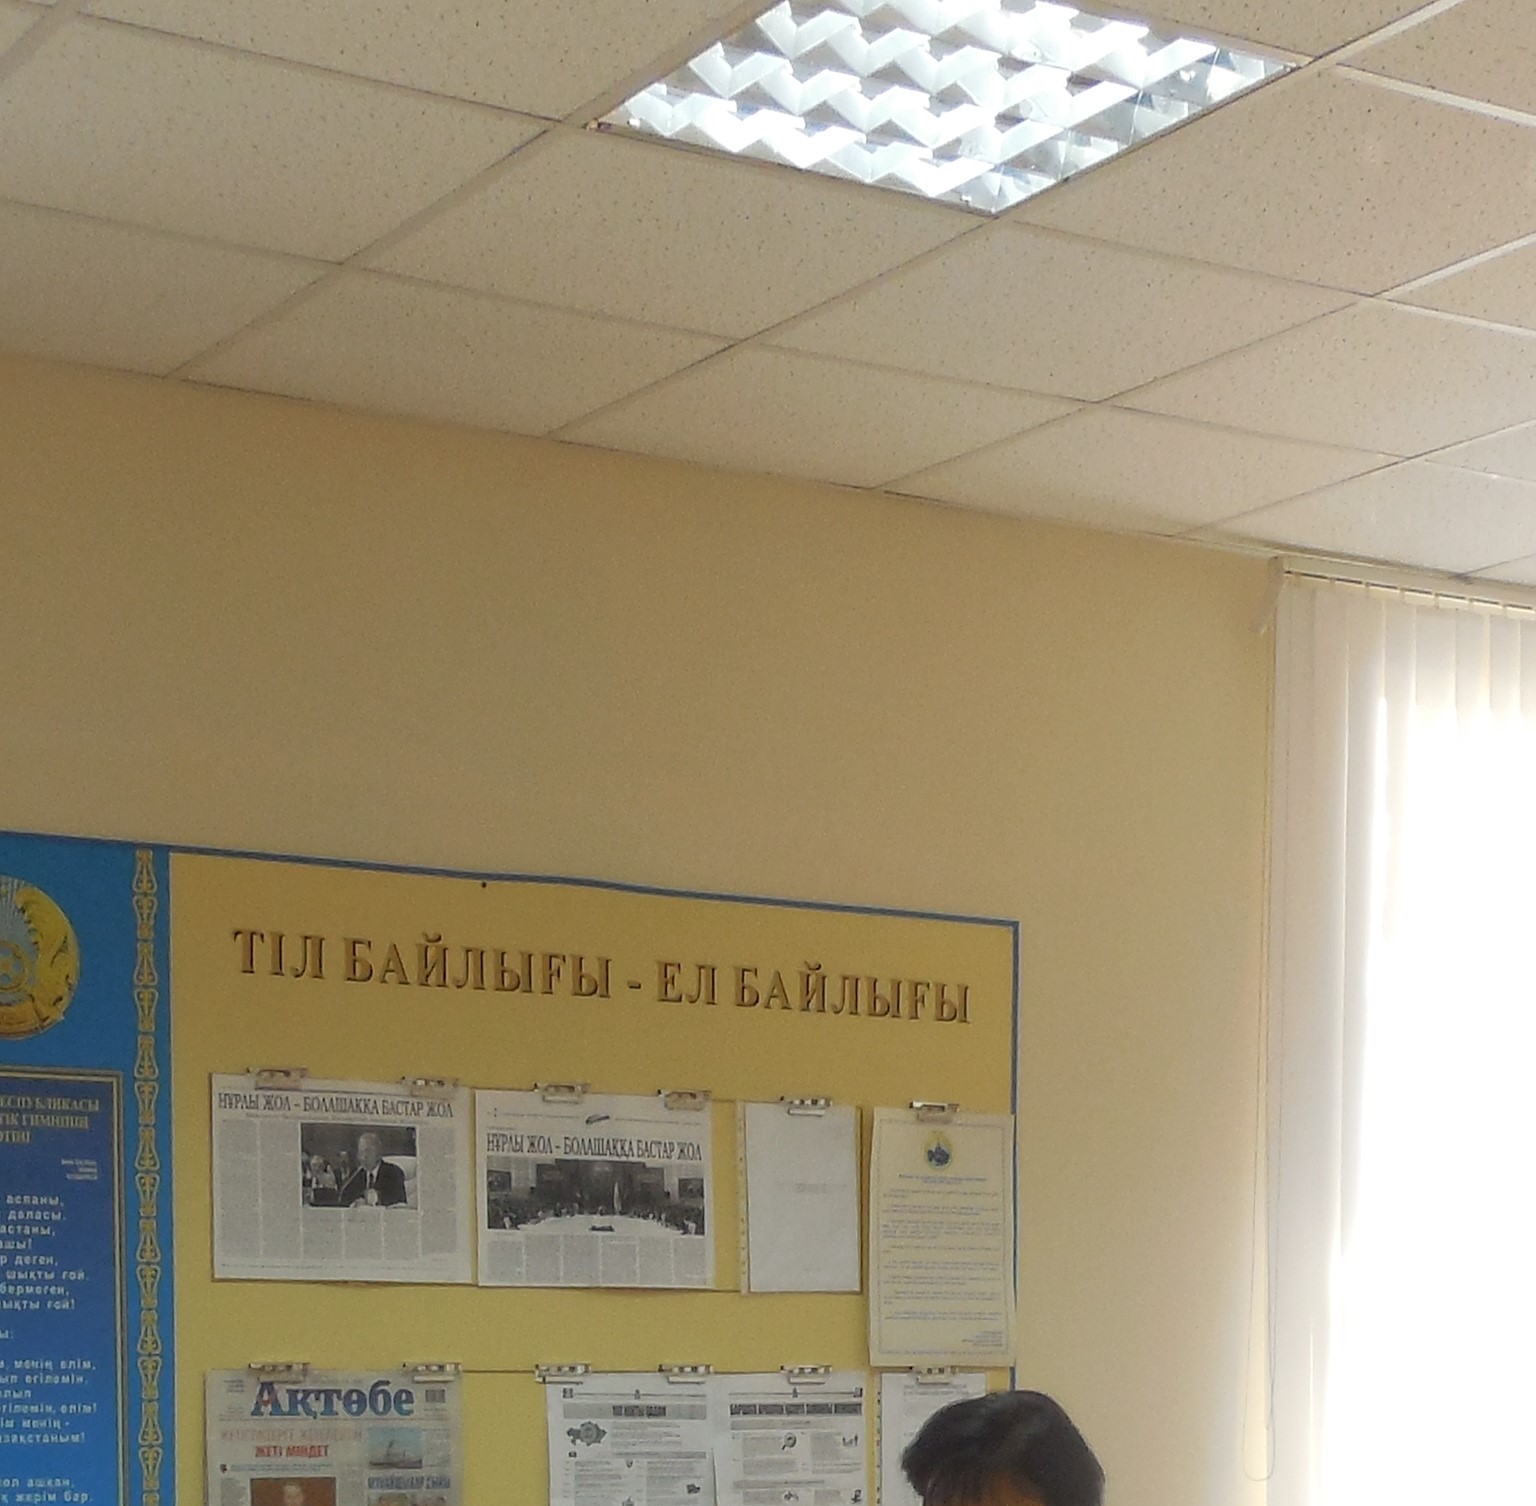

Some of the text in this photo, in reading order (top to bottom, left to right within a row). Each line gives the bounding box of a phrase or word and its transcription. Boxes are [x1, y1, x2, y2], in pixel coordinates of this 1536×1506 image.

[232, 928, 971, 1024] ТІЛ БАЙЛЫҒЫ - ЕЛ БАЙЛЫҒЫ
[263, 1096, 290, 1111] ЖОЛ
[382, 1099, 423, 1117] БАСТАР
[426, 1102, 453, 1118] ЖОЛ
[527, 1135, 552, 1154] ЖОЛ
[637, 1139, 675, 1160] БАСТАР
[676, 1143, 702, 1161] ЖОЛ
[250, 1379, 415, 1420] Ақтөбе
